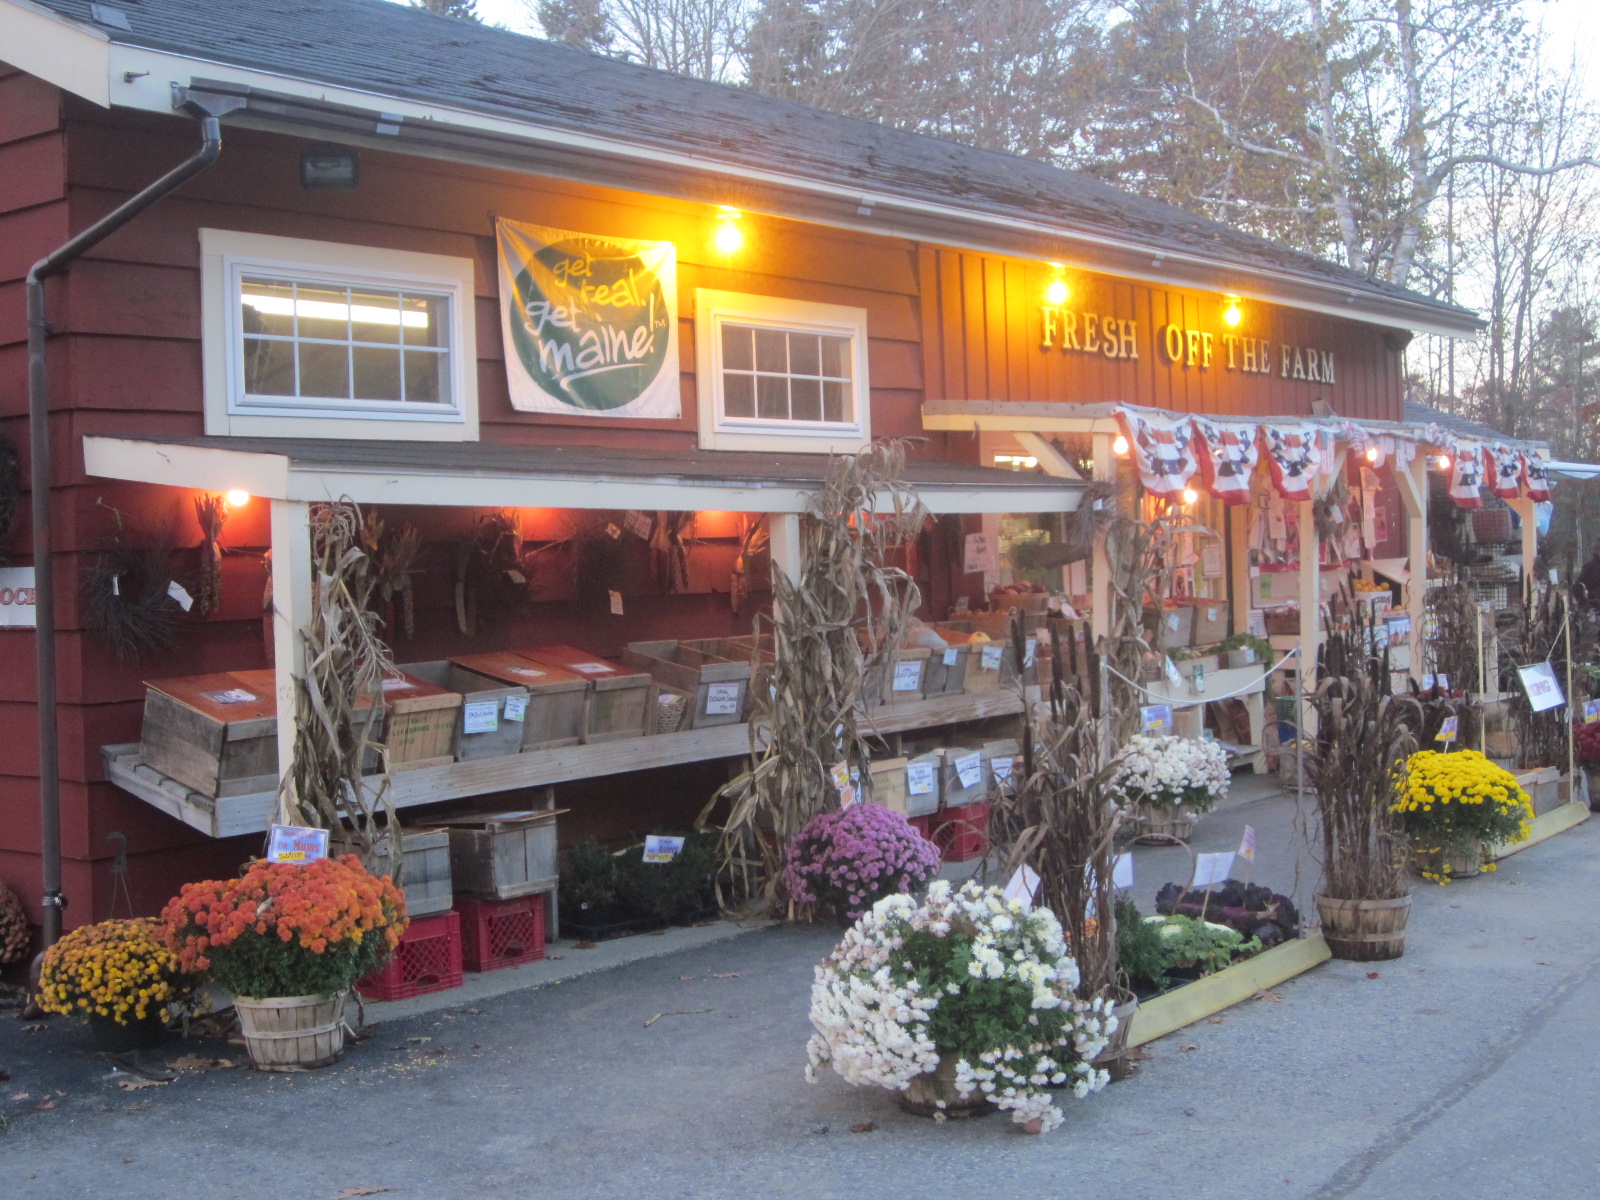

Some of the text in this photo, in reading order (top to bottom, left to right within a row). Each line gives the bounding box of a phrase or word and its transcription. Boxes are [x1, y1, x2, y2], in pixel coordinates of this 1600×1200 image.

[553, 251, 597, 287] get
[580, 268, 646, 308] real.
[524, 296, 583, 336] get
[538, 292, 655, 373] maine!
[1041, 306, 1336, 384] FRESH OFF THE FARM
